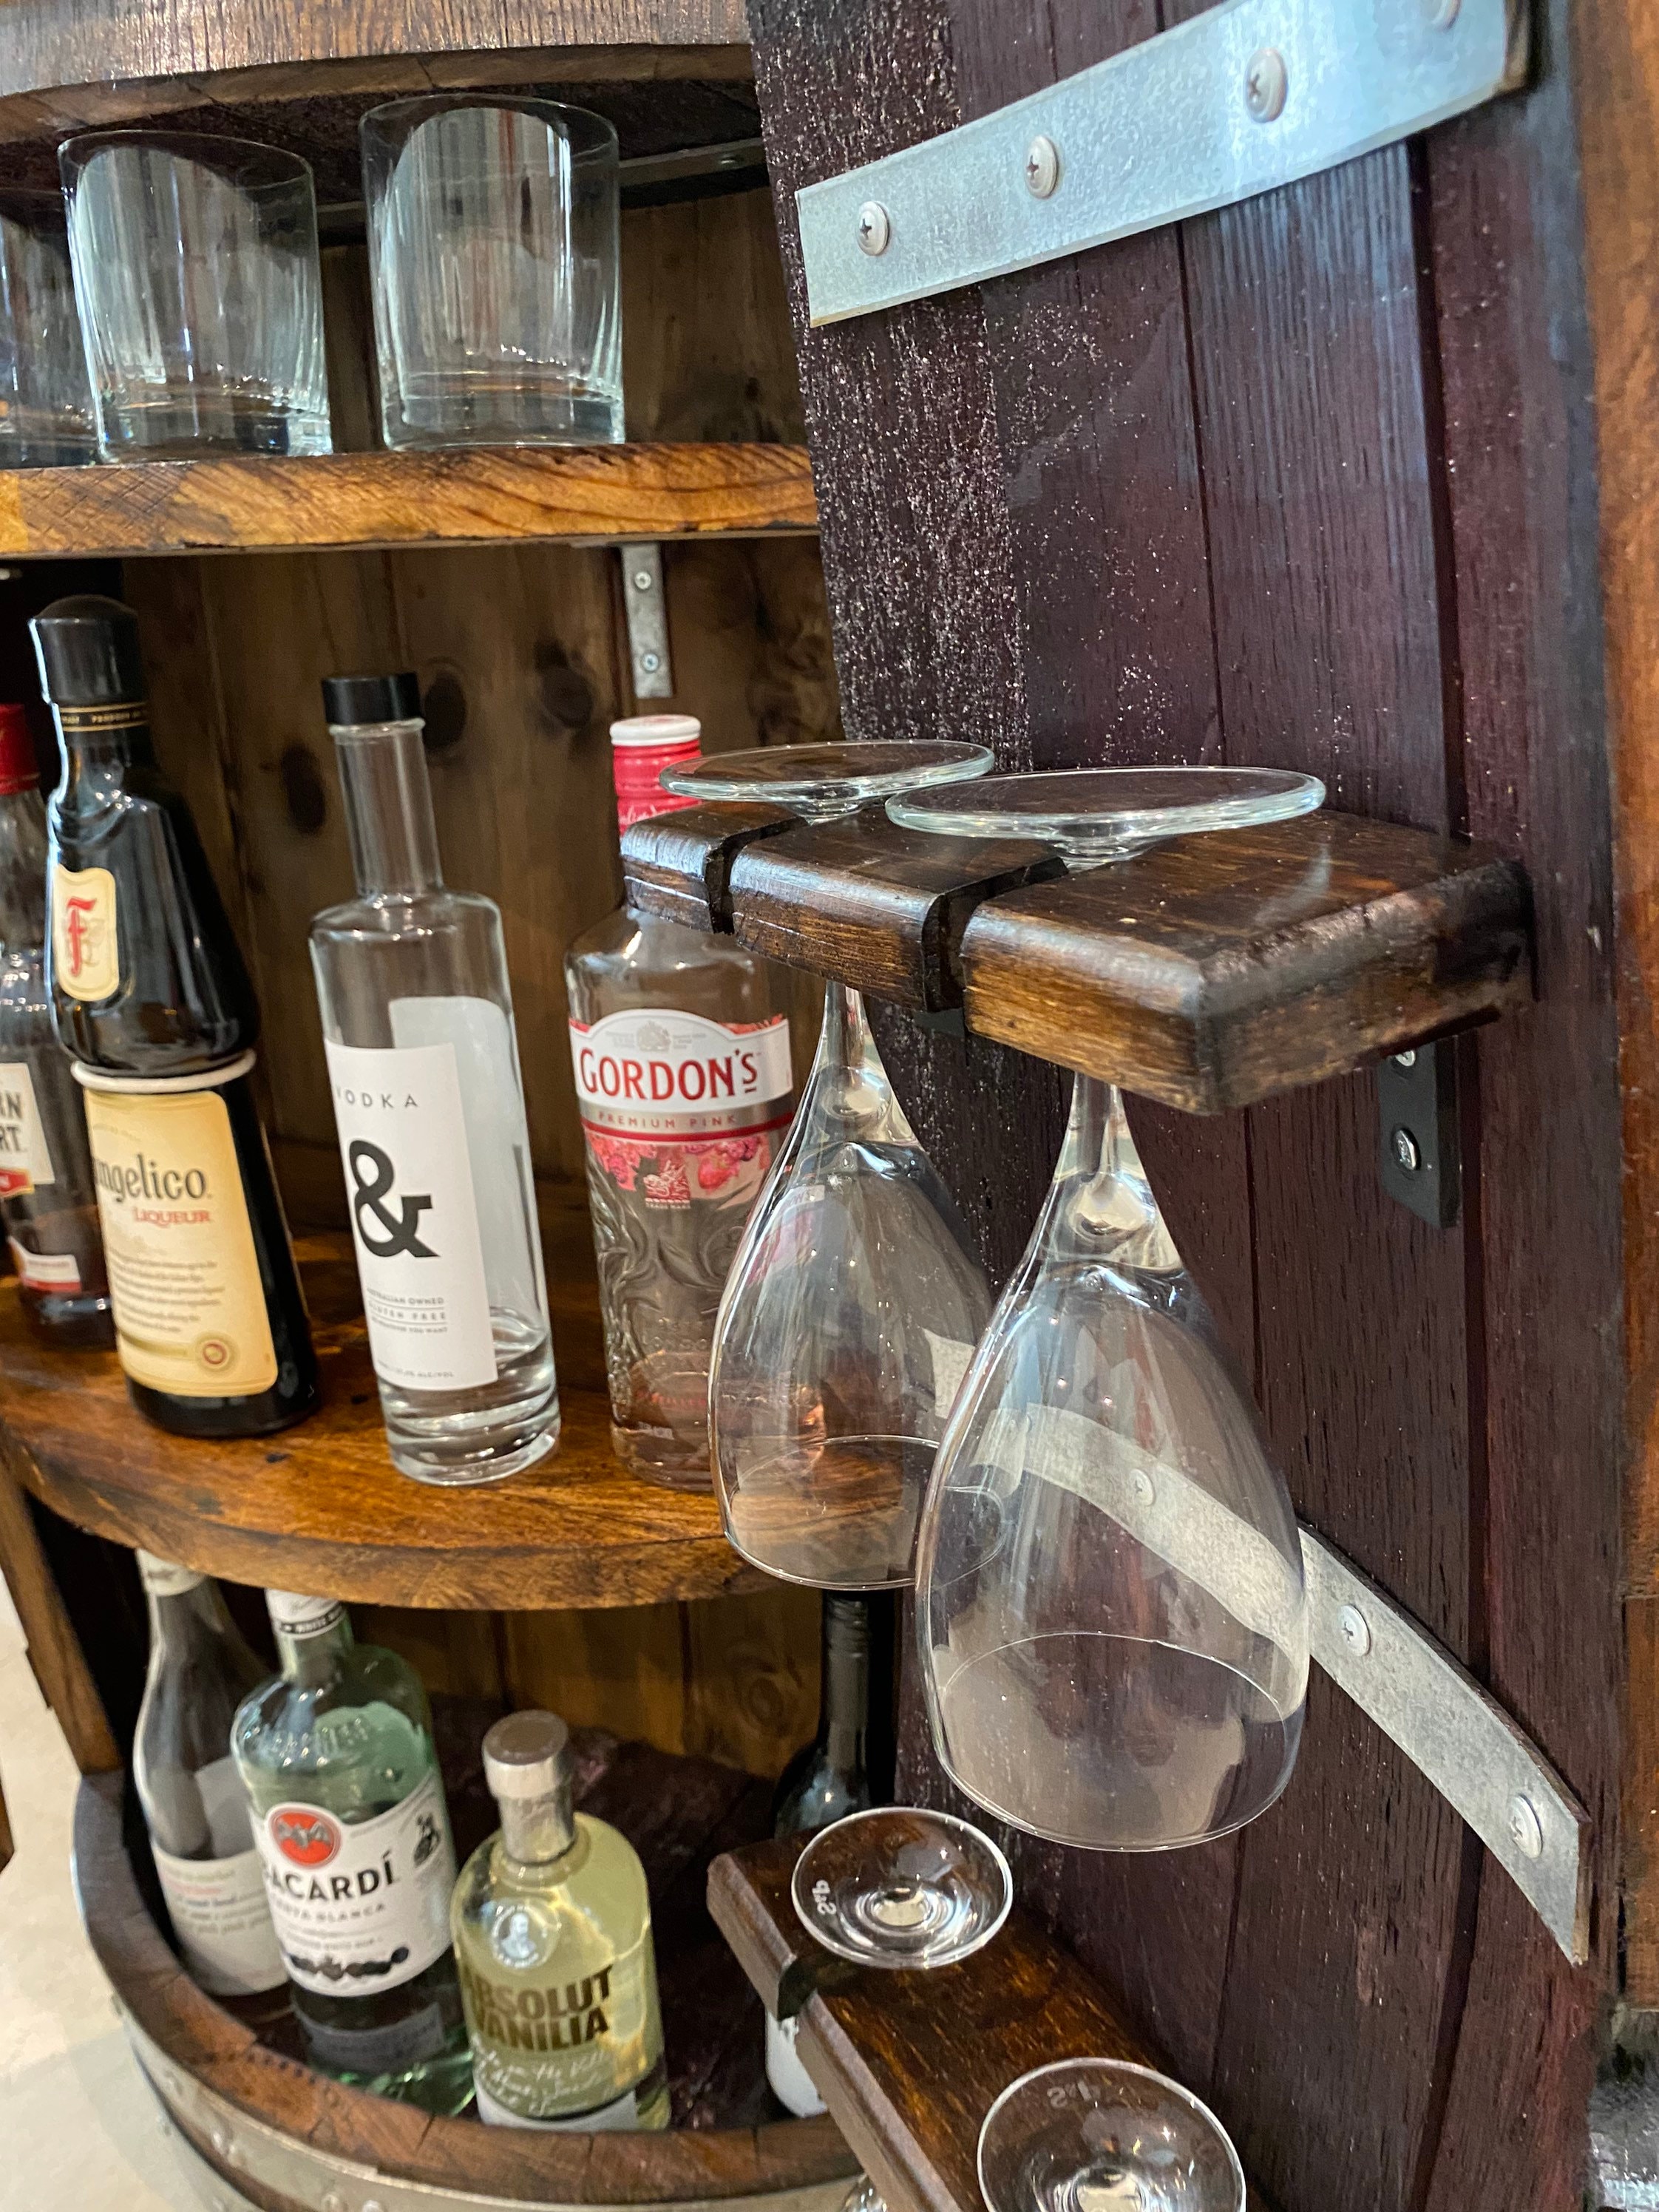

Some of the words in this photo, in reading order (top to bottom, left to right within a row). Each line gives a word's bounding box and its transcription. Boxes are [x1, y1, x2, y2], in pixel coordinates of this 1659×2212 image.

[579, 1048, 758, 1101] GORDON'S
[599, 1112, 675, 1128] PREMIUM
[689, 1114, 736, 1128] PINK
[348, 1139, 441, 1258] &
[132, 1207, 209, 1228] LIQUEUR
